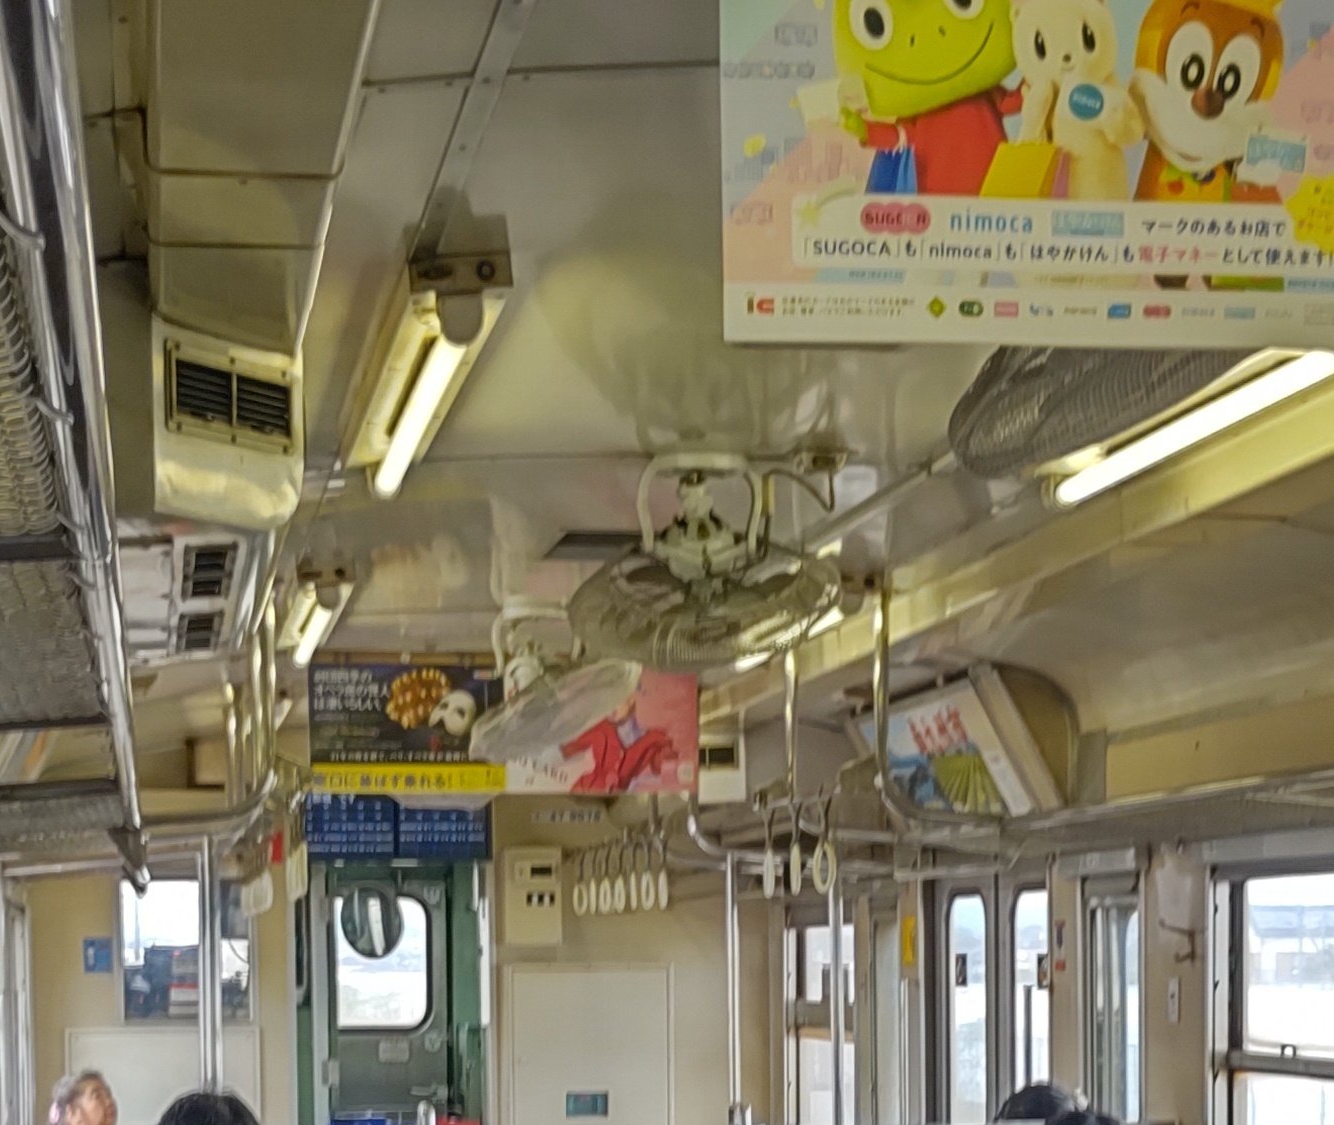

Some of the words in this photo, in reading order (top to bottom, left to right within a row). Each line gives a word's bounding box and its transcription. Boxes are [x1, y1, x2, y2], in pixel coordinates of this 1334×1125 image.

[950, 208, 1034, 234] nimoca
[1141, 217, 1287, 238] マークのあるお店で
